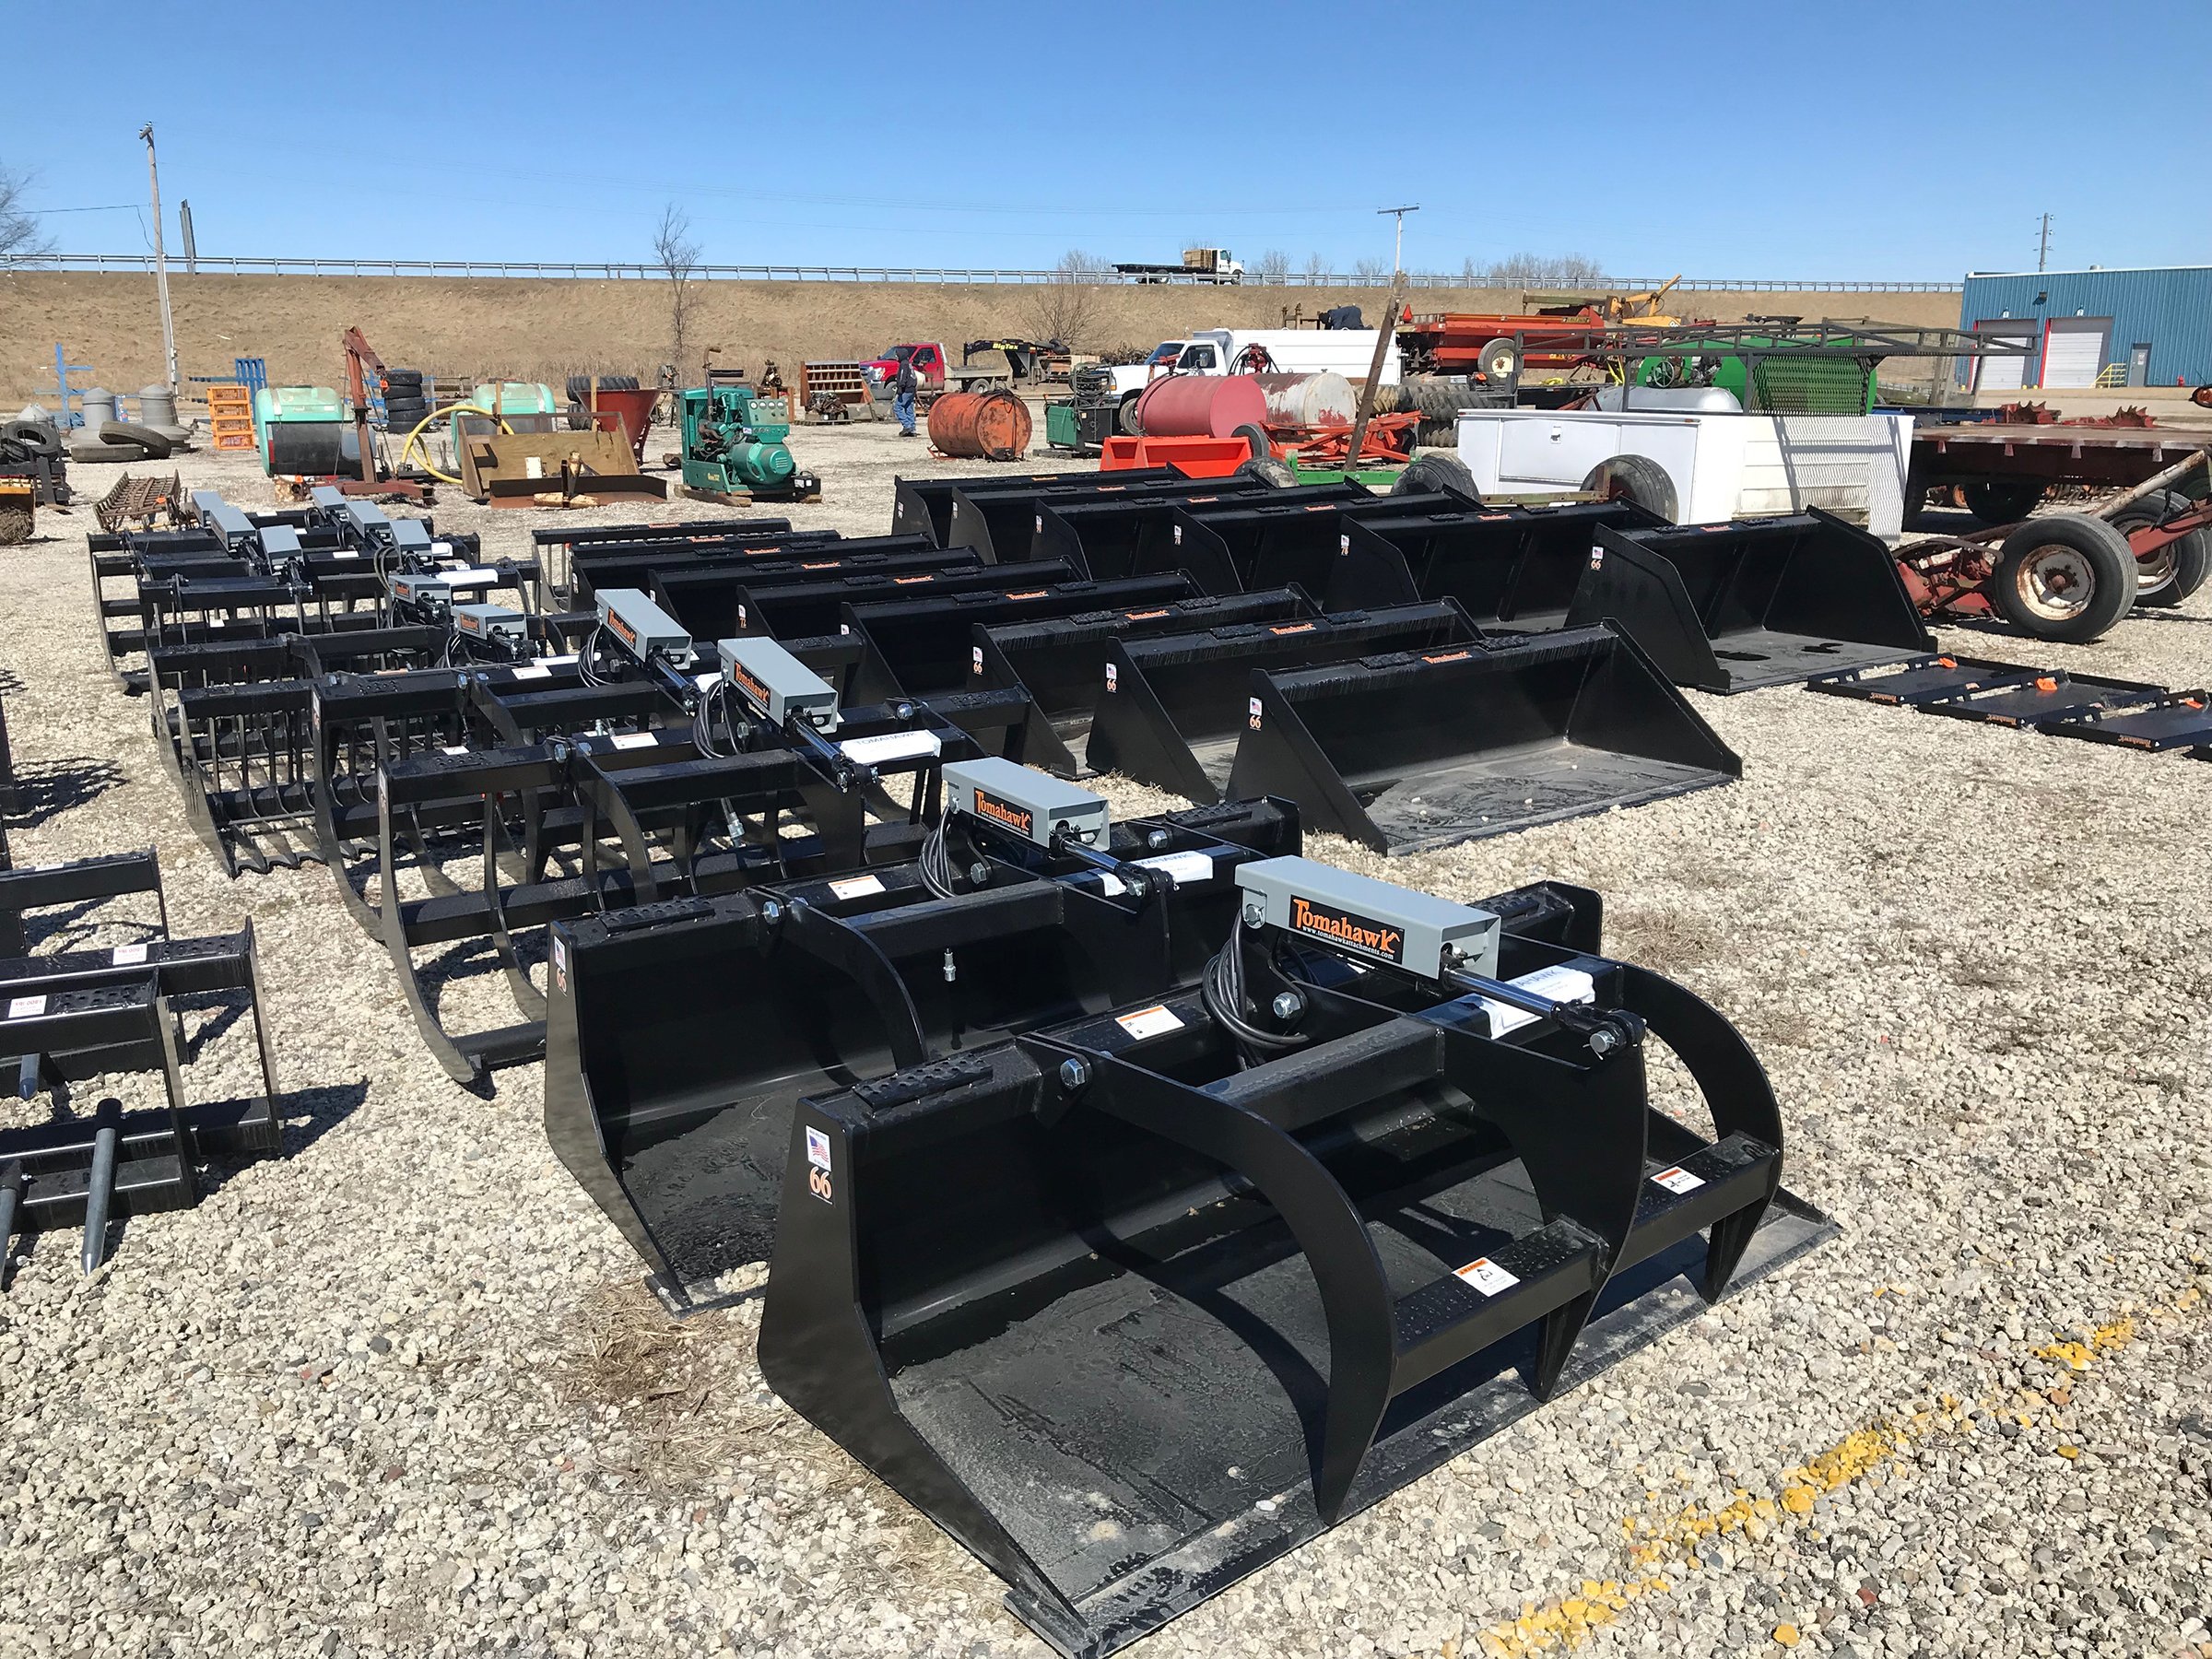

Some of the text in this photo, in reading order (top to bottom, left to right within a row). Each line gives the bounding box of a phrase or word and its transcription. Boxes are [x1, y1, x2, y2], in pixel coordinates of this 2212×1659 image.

[1591, 559, 1602, 570] 66
[735, 662, 771, 702] Tomahawk
[973, 662, 983, 673] 66
[1106, 679, 1117, 691] 66
[1249, 715, 1262, 729] 66
[975, 790, 1031, 830] Tomahawk
[1293, 898, 1400, 953] Tomahawk
[1302, 925, 1394, 960] www.tomahawkattachments.com
[557, 967, 567, 993] 66
[809, 1166, 832, 1199] 66
